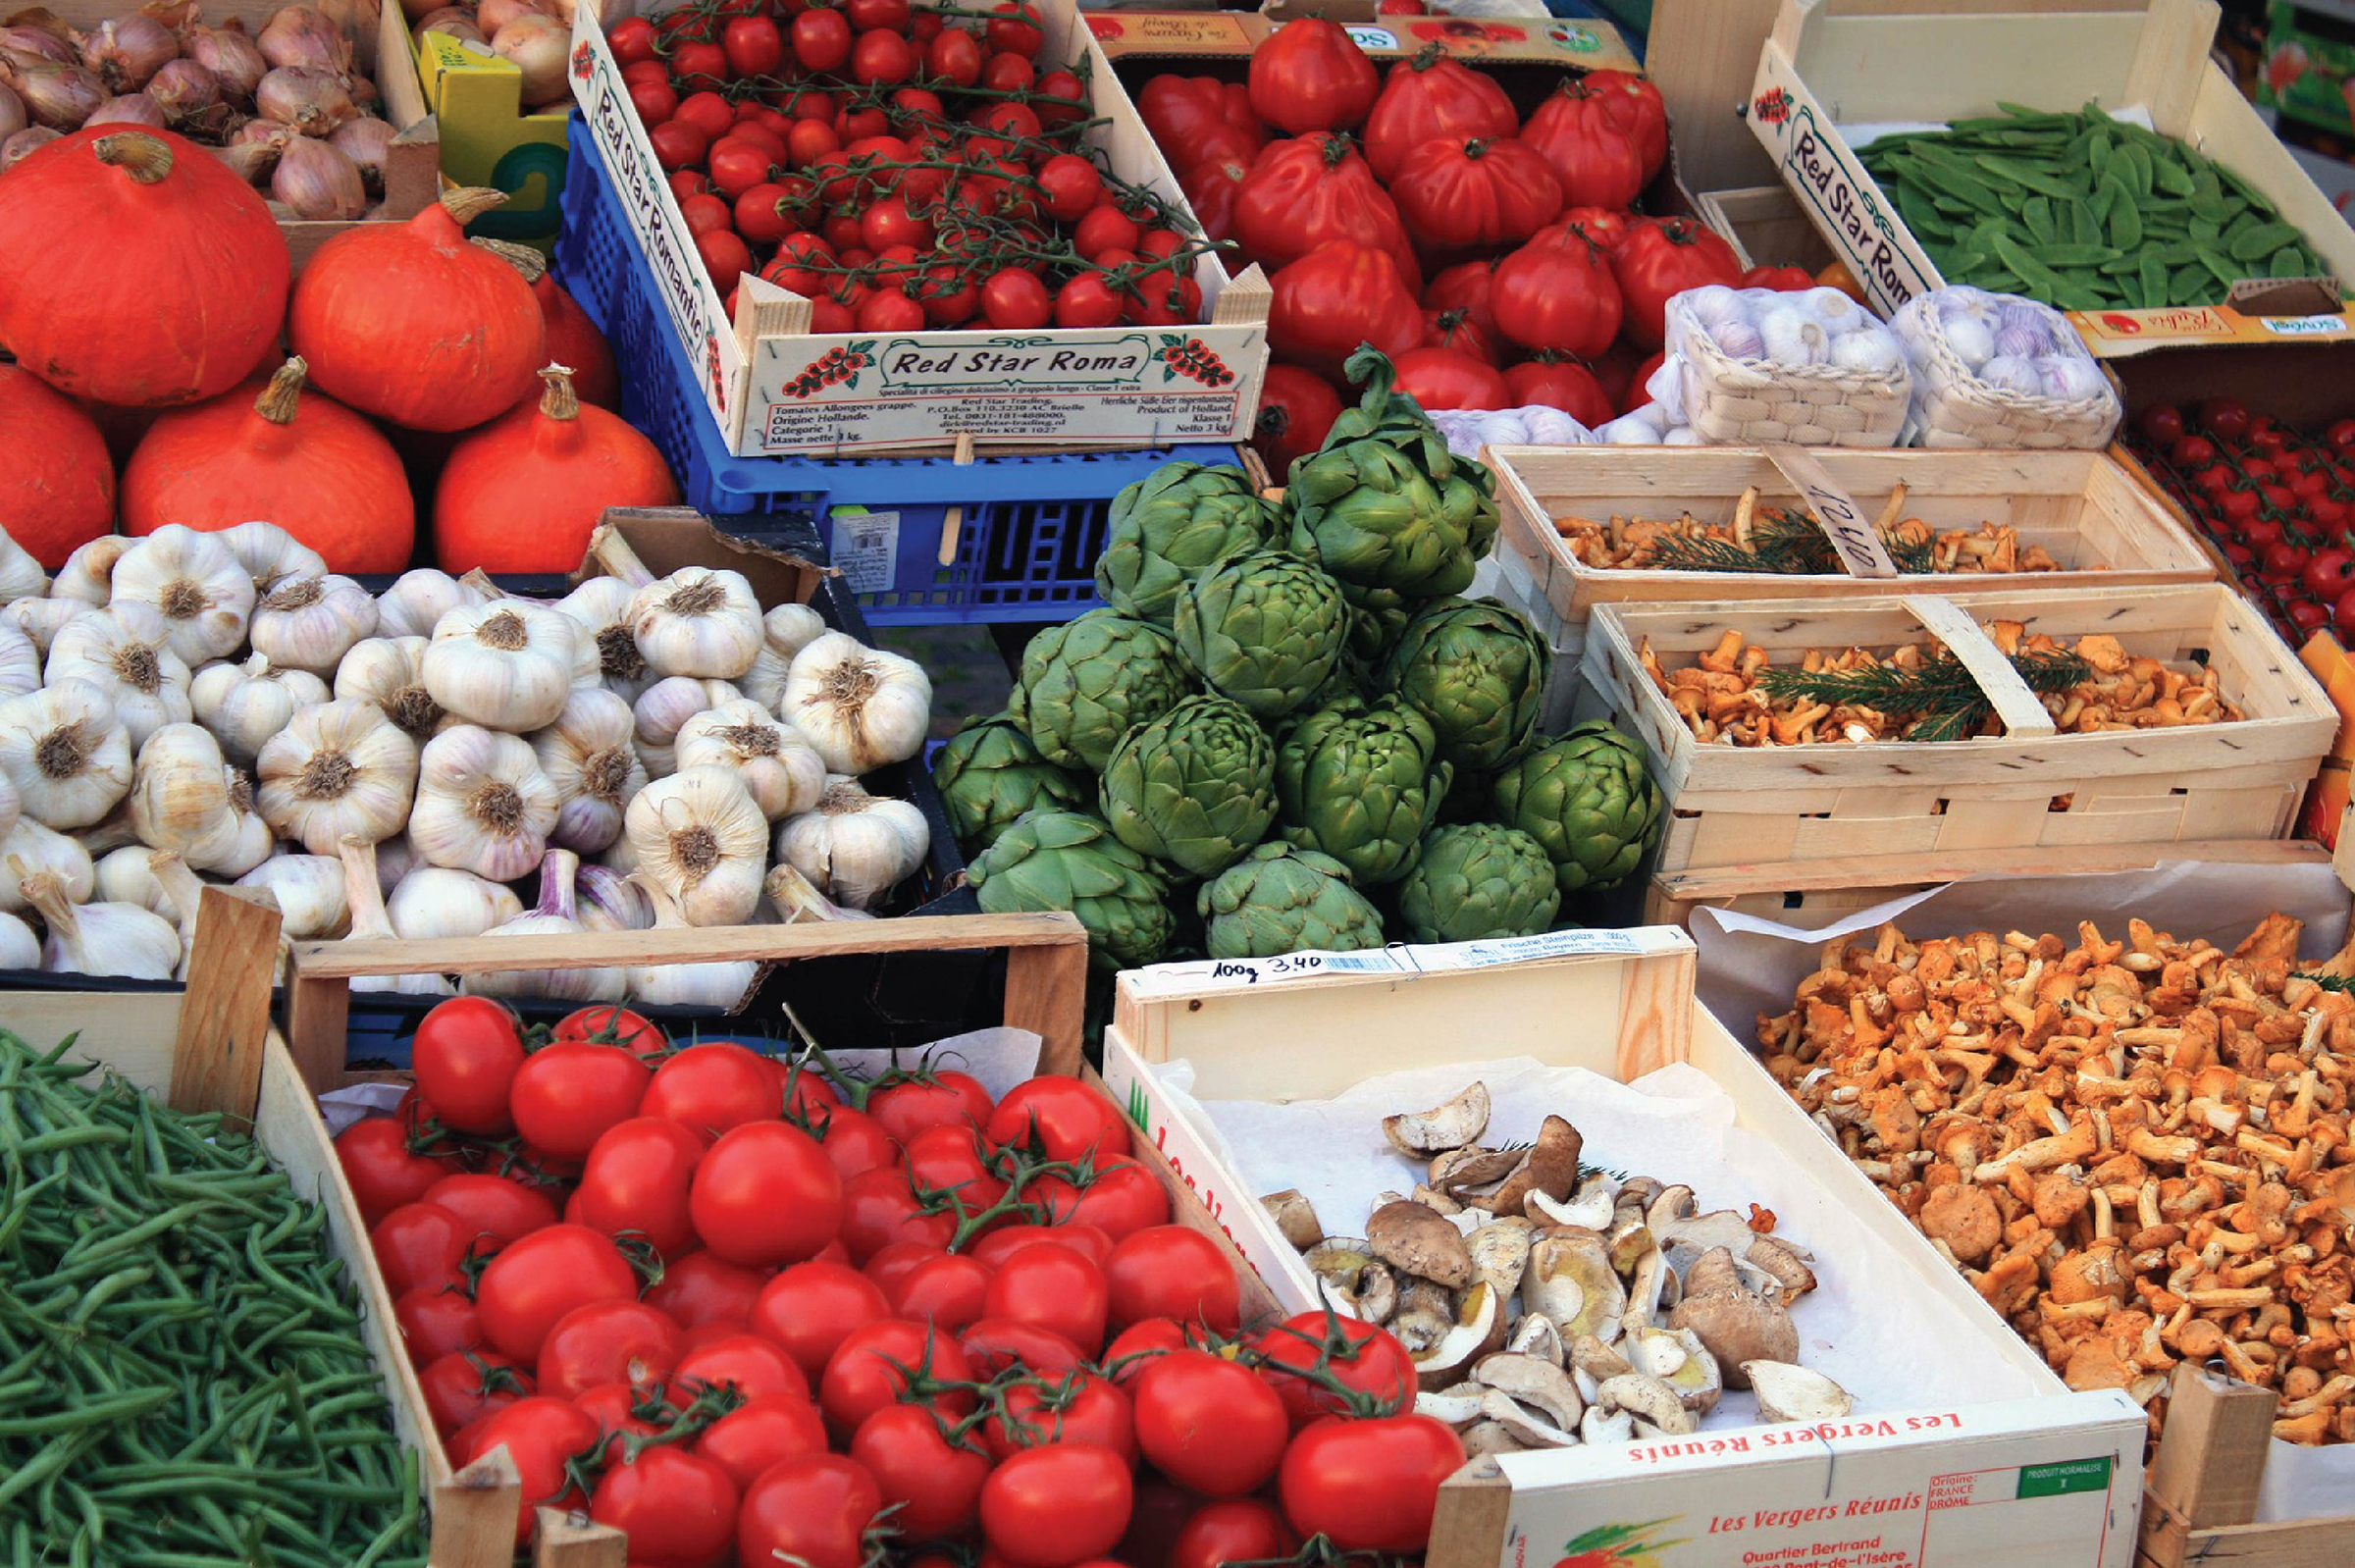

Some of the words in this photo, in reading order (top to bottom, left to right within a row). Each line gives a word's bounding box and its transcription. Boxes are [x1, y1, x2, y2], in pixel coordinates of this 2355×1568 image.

[1795, 131, 1834, 194] Red
[1829, 183, 1873, 246] Star
[598, 88, 621, 151] Red
[621, 141, 650, 213] Star
[650, 206, 703, 340] Romantic
[892, 352, 958, 374] Red
[965, 351, 1039, 373] Star
[1048, 350, 1137, 372] Roma
[775, 406, 819, 415] Tomates
[1137, 405, 1177, 414] Product
[1178, 404, 1188, 413] of
[772, 415, 814, 426] Origine
[817, 412, 869, 423] Hollande.
[1192, 414, 1223, 423] Klasse
[772, 425, 823, 436] Categorie
[1176, 424, 1203, 433] Netto
[770, 436, 804, 444] Masse
[807, 434, 834, 443] nette
[1543, 932, 1596, 944] Steinpilze
[1909, 1413, 1963, 1431] Les
[1762, 1420, 1898, 1446] Vergers
[1627, 1437, 1751, 1464] Réunis
[2027, 1467, 2060, 1480] PRODUIT
[1932, 1475, 1978, 1488] Origine:
[1930, 1485, 1974, 1497] FRANCE
[1708, 1515, 1746, 1534] Les
[1753, 1504, 1839, 1529] Vergers
[1844, 1491, 1922, 1518] Réunis
[1743, 1546, 1808, 1563] Quartier
[1811, 1537, 1881, 1556] Bertrand
